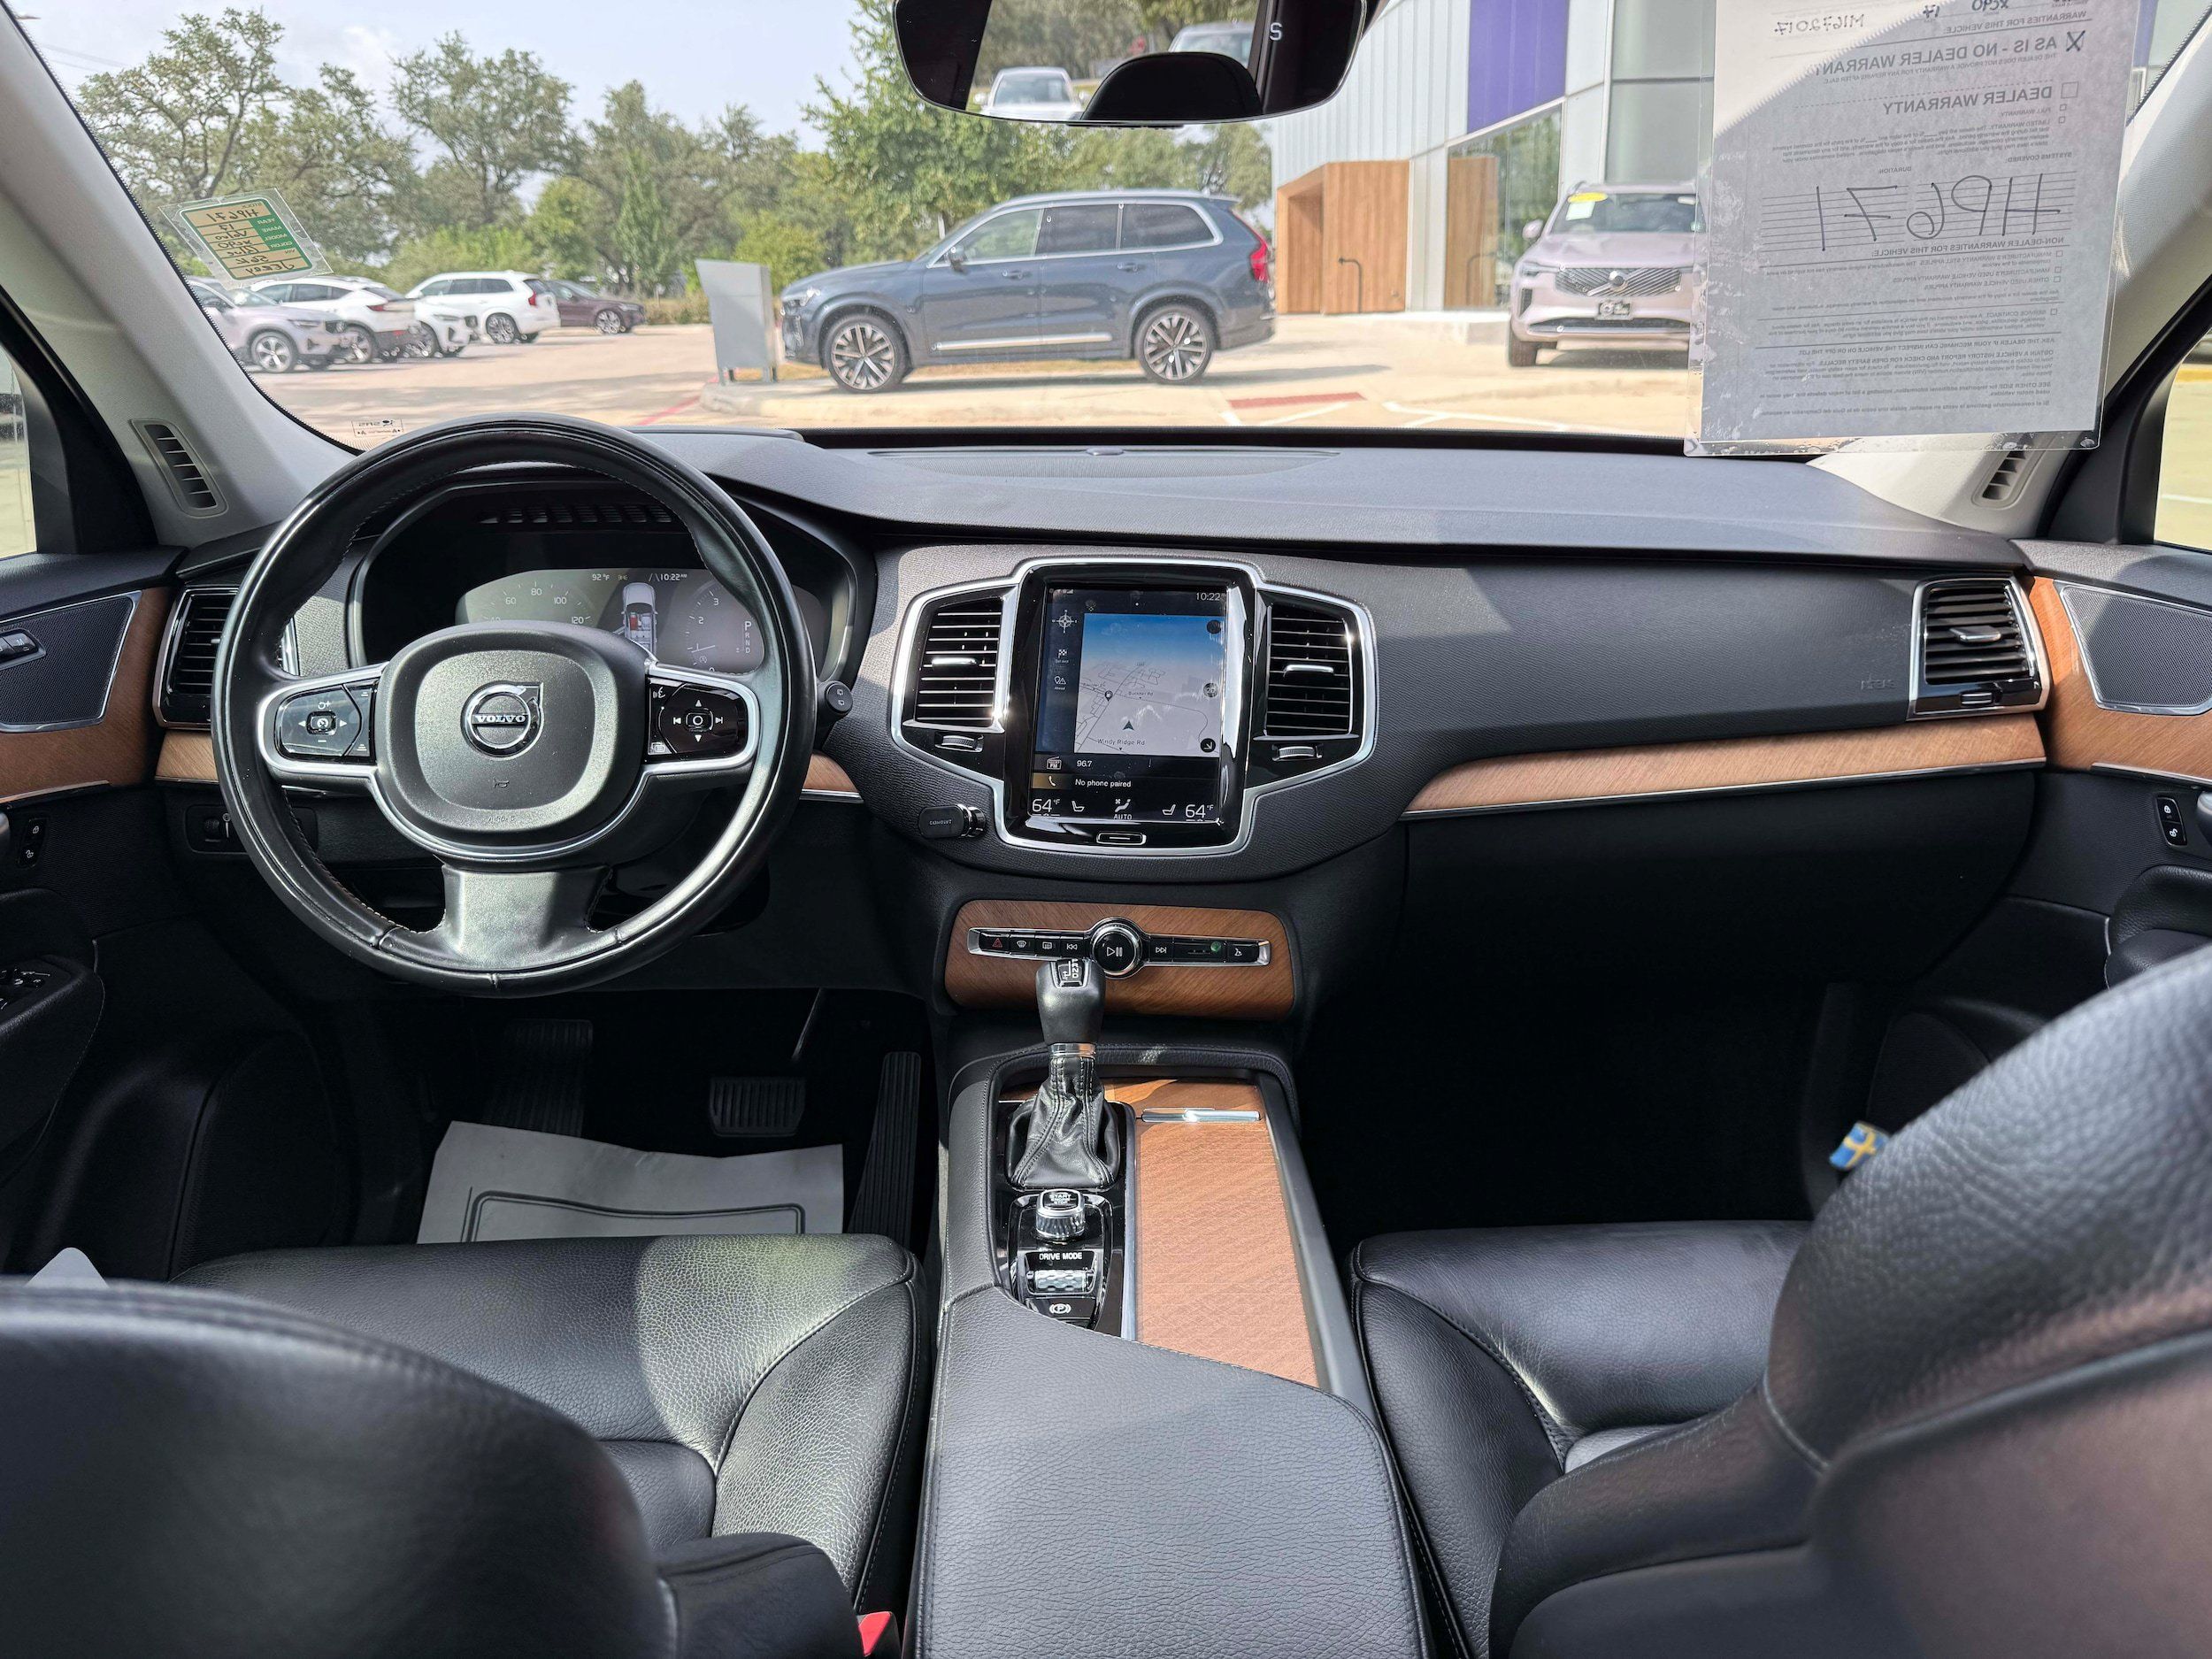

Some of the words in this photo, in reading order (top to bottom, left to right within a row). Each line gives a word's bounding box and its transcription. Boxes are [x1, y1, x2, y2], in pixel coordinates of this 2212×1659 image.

[1269, 22, 1282, 41] S
[1195, 592, 1220, 602] 10:22
[571, 616, 584, 625] 120
[744, 620, 752, 631] P
[475, 714, 526, 723] VOLVO
[1087, 780, 1109, 788] phone
[1110, 780, 1132, 789] paired
